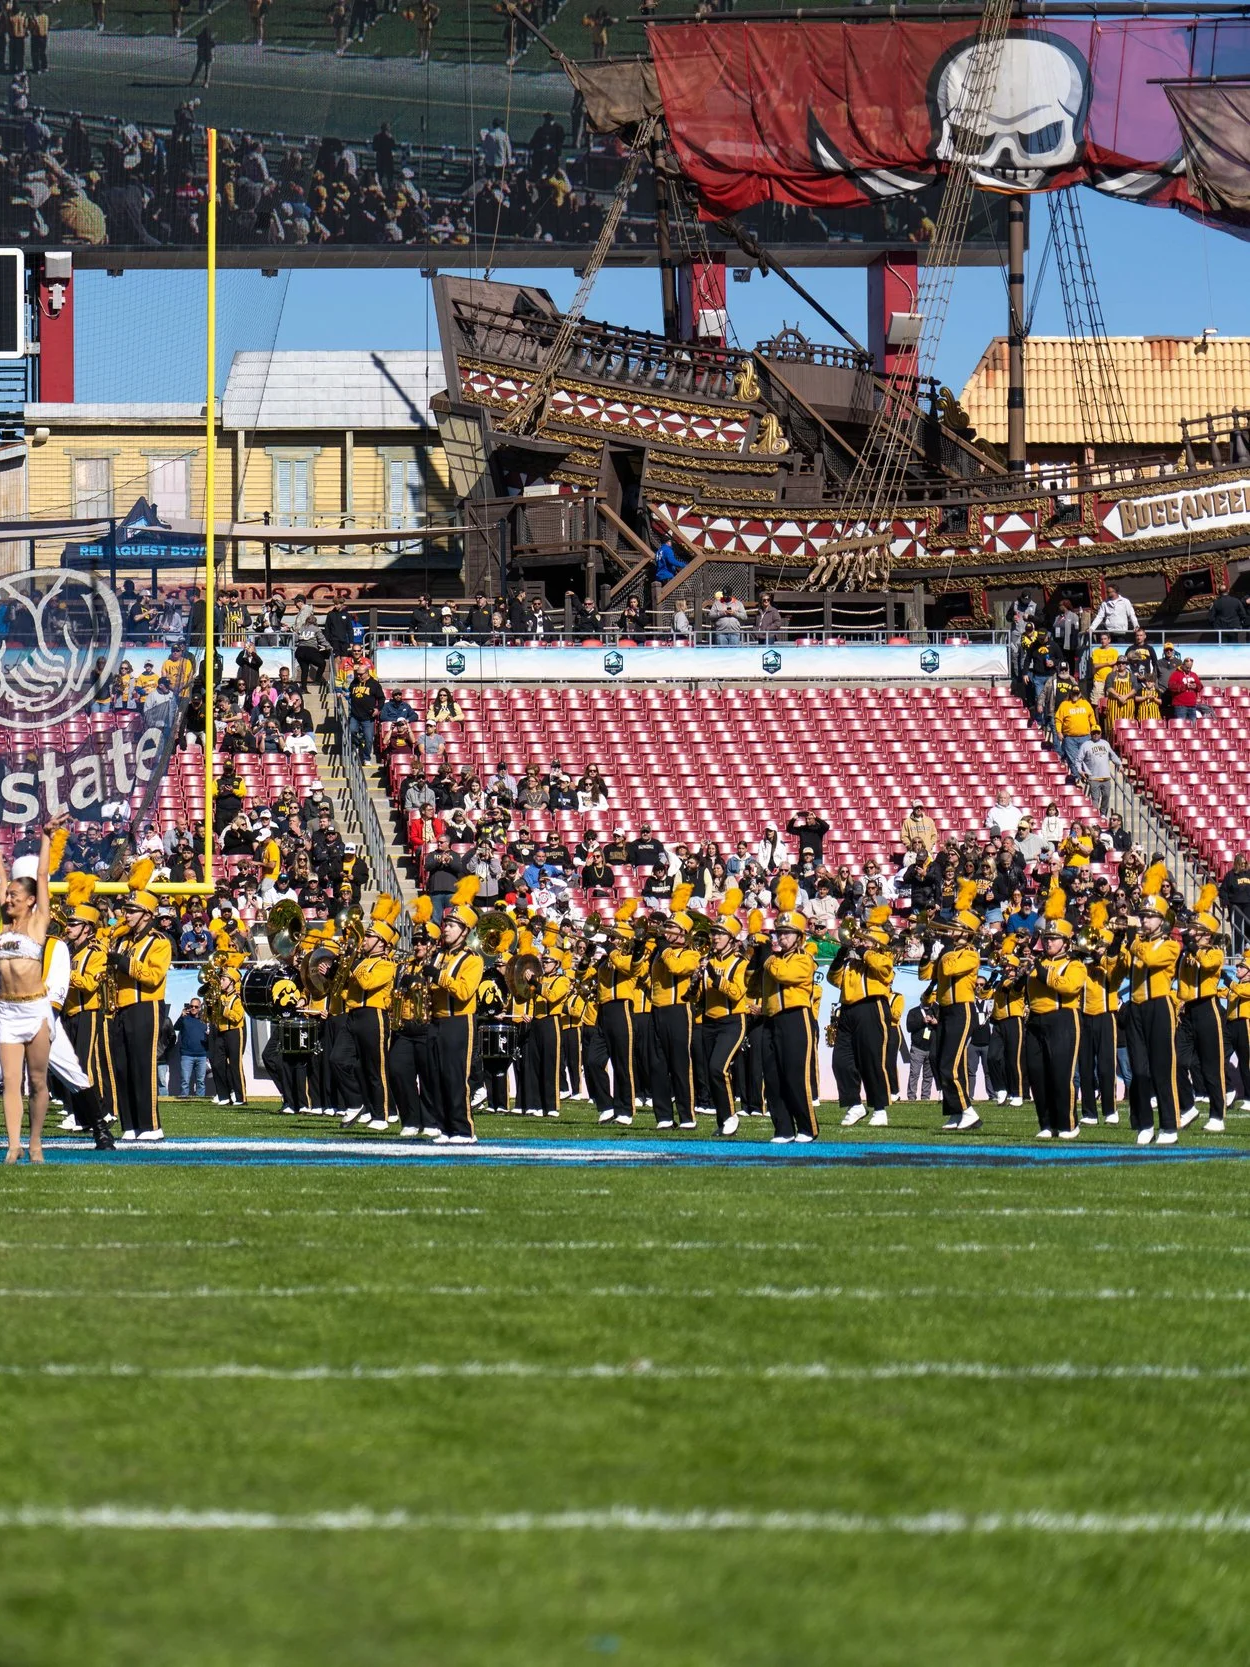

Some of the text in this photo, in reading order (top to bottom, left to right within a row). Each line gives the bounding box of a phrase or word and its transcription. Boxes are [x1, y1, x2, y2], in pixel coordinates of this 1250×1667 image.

[79, 545, 207, 556] RELQUEST BOW
[352, 685, 371, 696] IOWA
[1056, 682, 1073, 690] OWA
[1091, 745, 1108, 754] IOWA
[299, 1029, 309, 1049] Pearl
